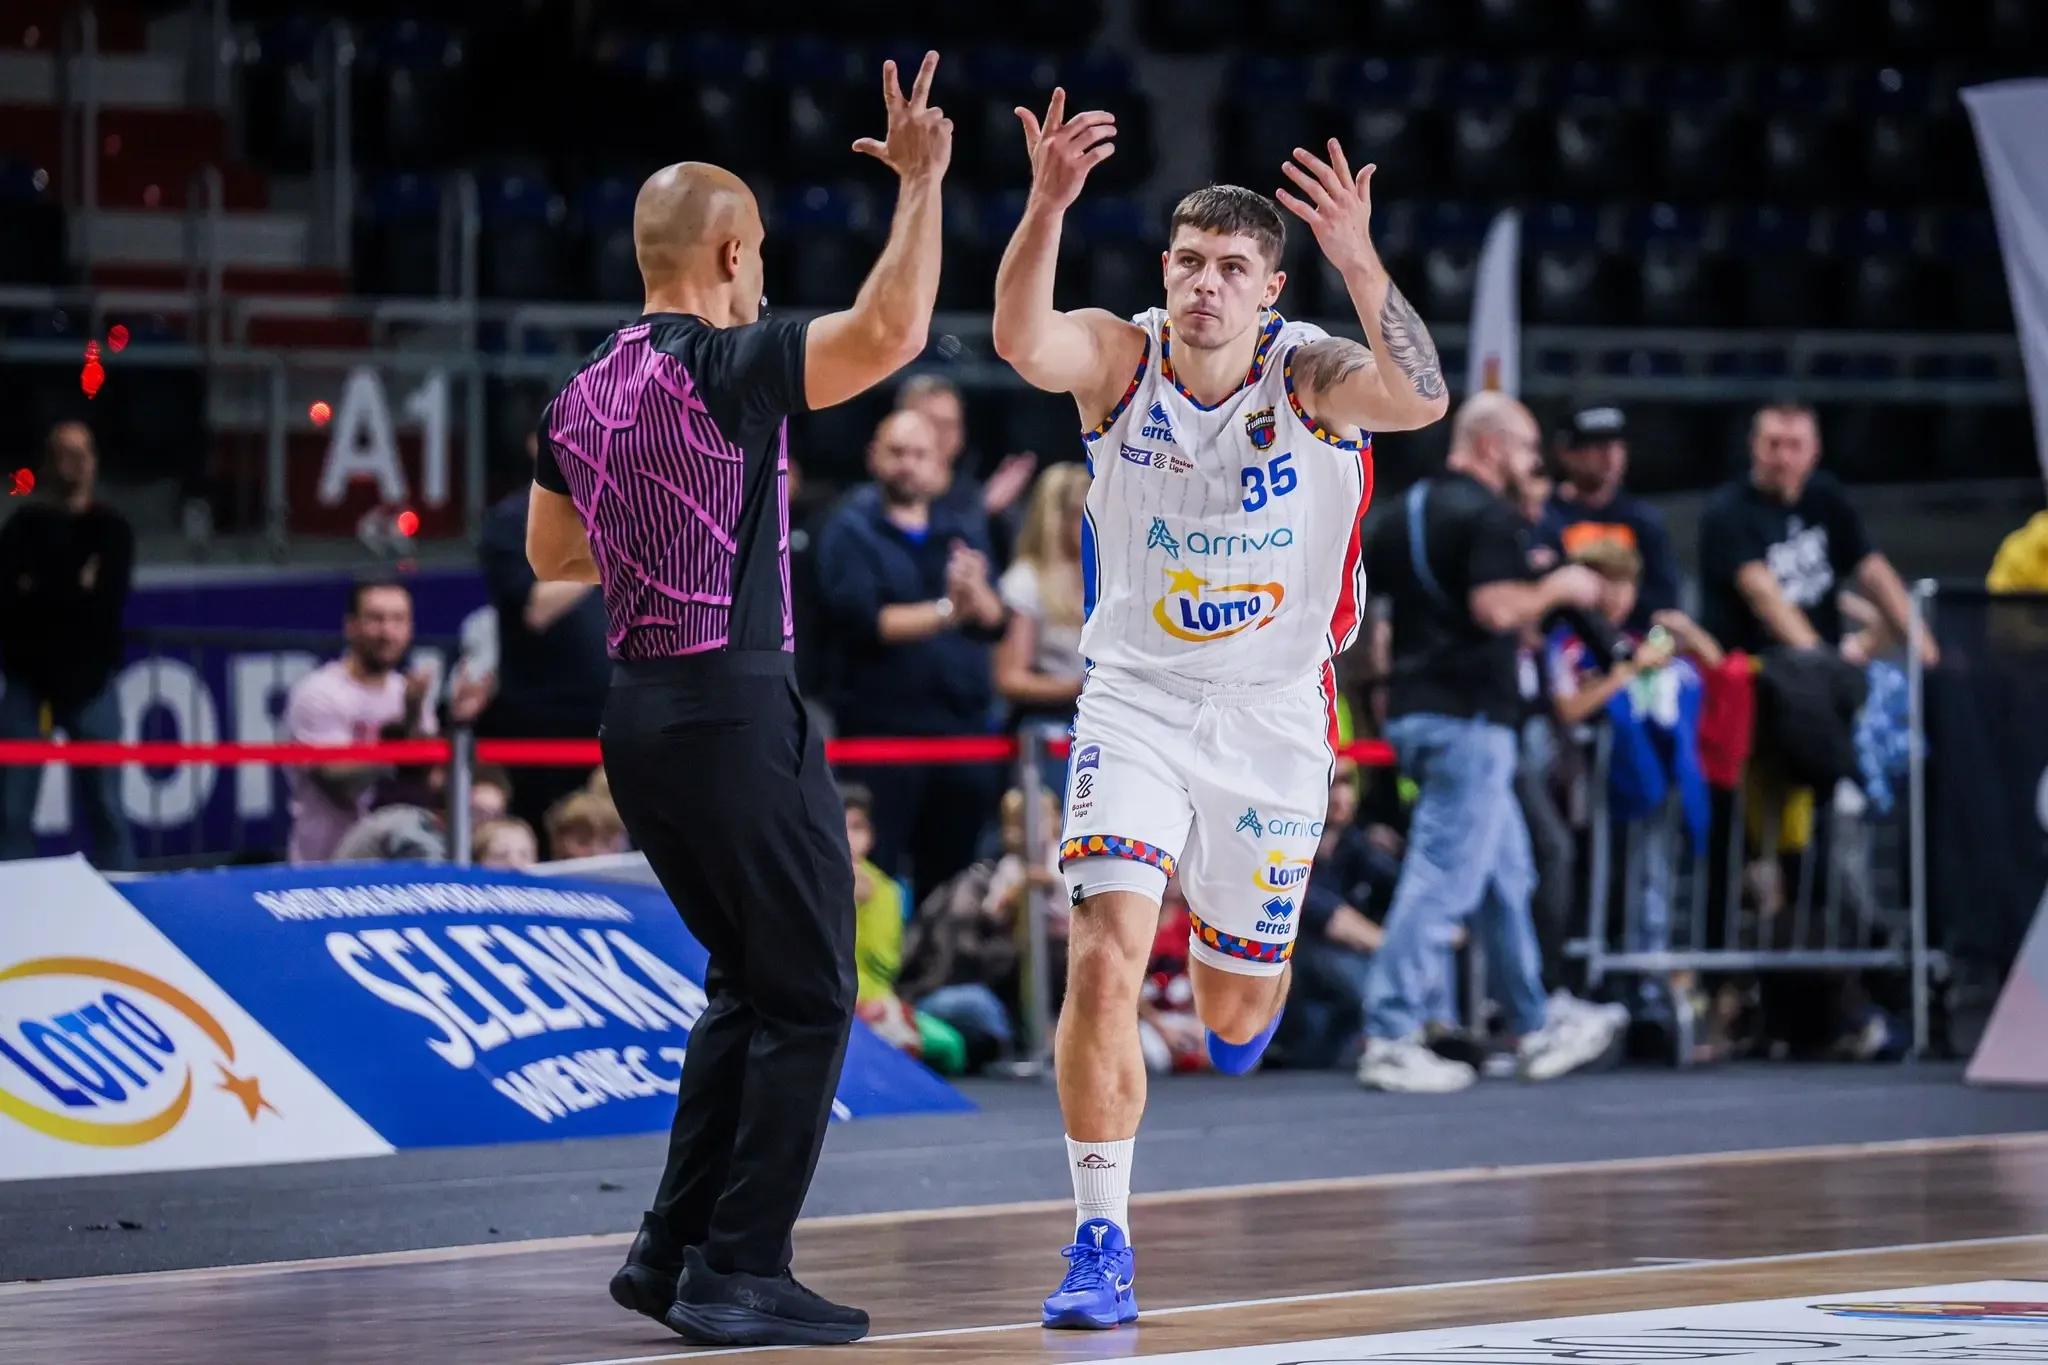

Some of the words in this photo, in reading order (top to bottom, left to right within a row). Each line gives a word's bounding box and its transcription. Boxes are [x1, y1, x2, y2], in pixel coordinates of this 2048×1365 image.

[317, 366, 452, 506] A1
[1142, 426, 1177, 444] erre
[1121, 447, 1148, 462] PGE
[1170, 457, 1194, 469] Basket
[1169, 464, 1184, 473] Liga
[1241, 452, 1297, 512] 35
[1187, 528, 1293, 557] arriva
[1179, 596, 1261, 631] LOTTO
[1079, 752, 1097, 764] PGE
[1072, 802, 1093, 811] Basket
[1074, 810, 1088, 818] Liga
[1269, 866, 1309, 886] LOTTO
[325, 924, 709, 1070] SELENKA
[0, 993, 175, 1106] LOTTO
[492, 1045, 684, 1123] WIENIEC
[1077, 1161, 1117, 1169] PEAK
